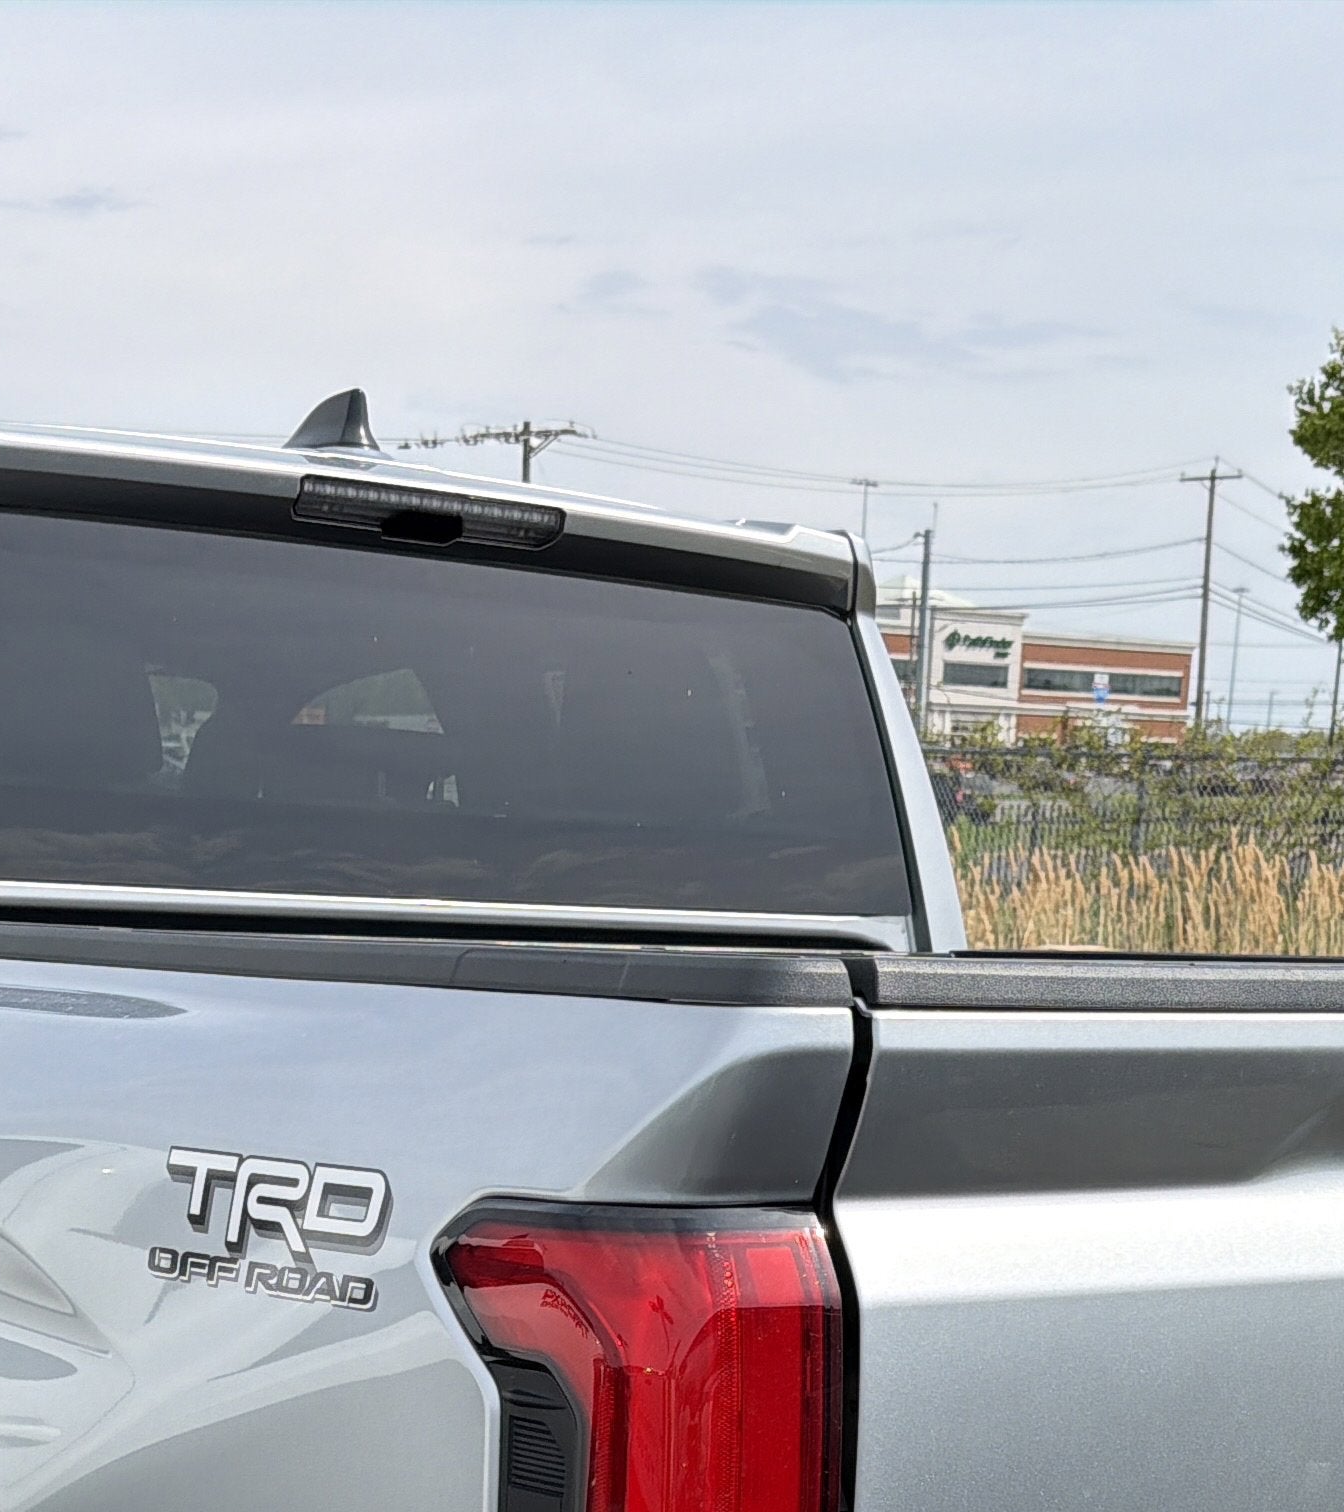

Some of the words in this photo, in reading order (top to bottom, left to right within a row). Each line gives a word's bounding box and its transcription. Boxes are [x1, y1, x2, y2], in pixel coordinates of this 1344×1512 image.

[166, 1145, 394, 1257] TRD
[147, 1246, 241, 1288] OFF
[244, 1260, 380, 1313] ROAD
